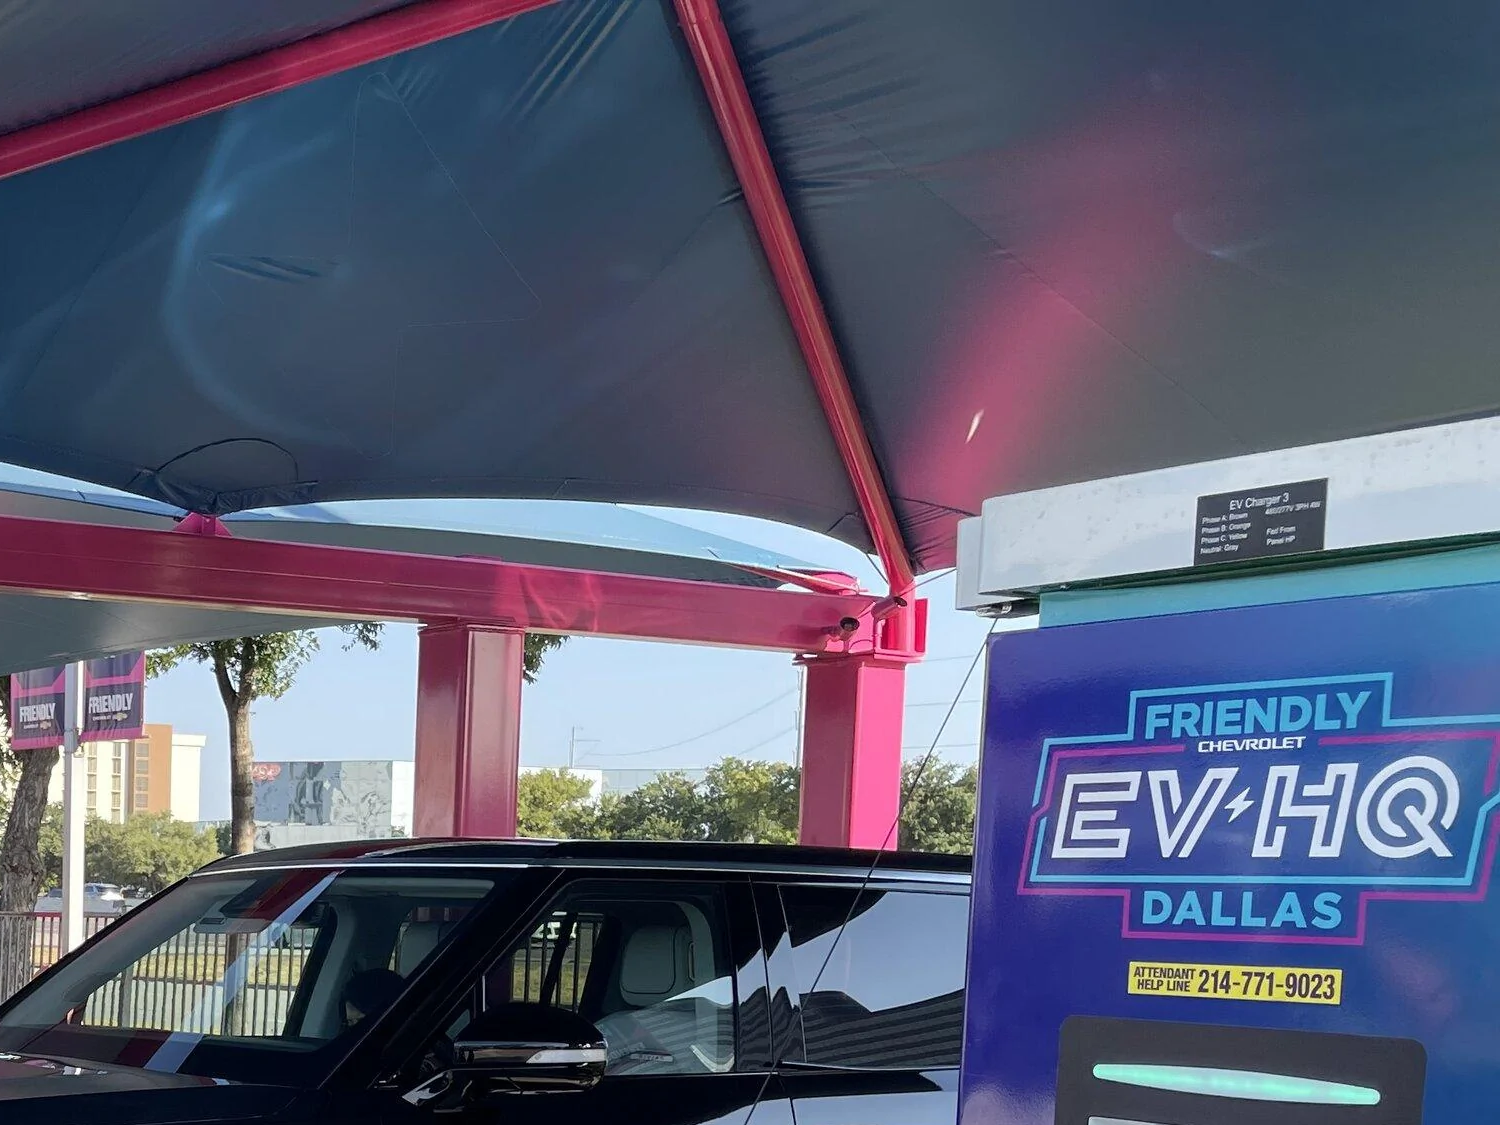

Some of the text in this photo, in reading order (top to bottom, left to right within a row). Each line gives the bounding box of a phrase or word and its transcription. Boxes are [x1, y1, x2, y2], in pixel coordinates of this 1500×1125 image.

[1229, 492, 1290, 511] EV Charger 3
[19, 702, 56, 723] FRIENDLY
[88, 693, 134, 715] FRIENDLY
[1145, 691, 1372, 740] FRIENDLY
[1197, 735, 1307, 754] CHEVROLET
[1142, 890, 1343, 930] DALLAS
[1133, 966, 1336, 1000] ATTENDANT 214-771-9023
[1137, 978, 1191, 993] HELP LINE
